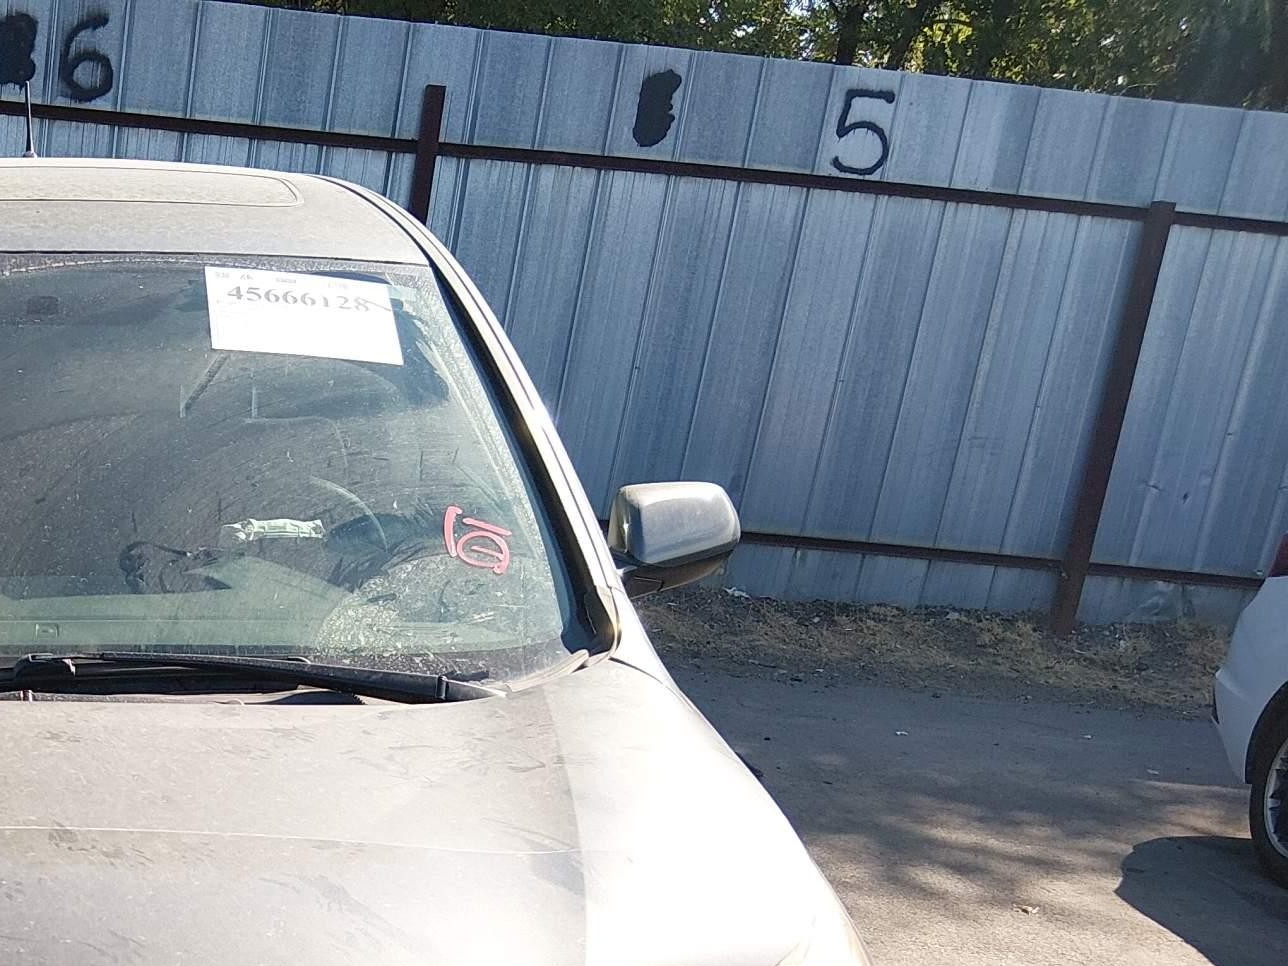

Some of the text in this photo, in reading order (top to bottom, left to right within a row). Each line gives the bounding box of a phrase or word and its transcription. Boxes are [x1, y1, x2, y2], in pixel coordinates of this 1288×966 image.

[57, 11, 114, 104] 6
[831, 88, 896, 176] 5
[227, 286, 370, 312] 45666128
